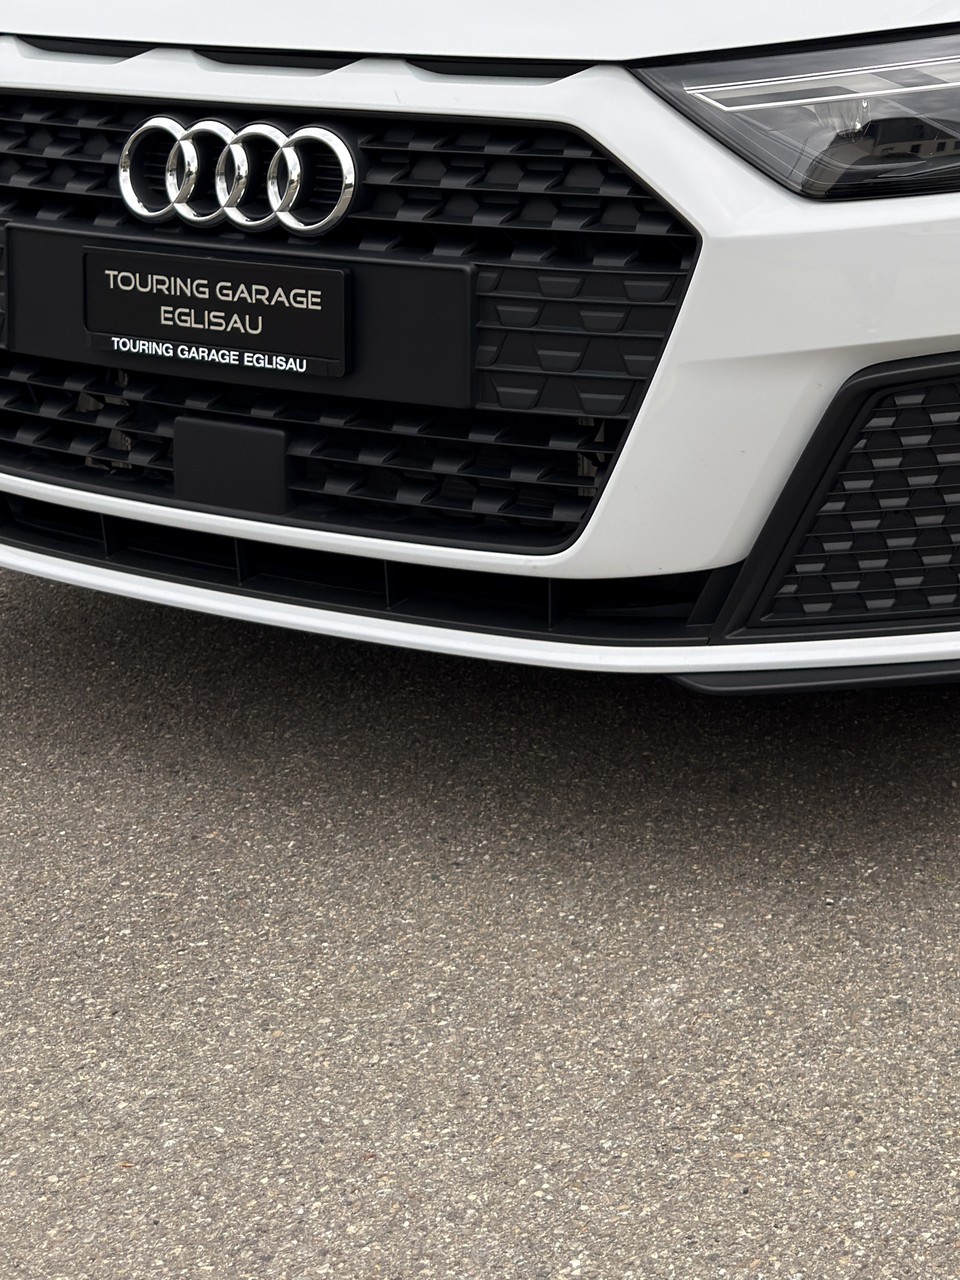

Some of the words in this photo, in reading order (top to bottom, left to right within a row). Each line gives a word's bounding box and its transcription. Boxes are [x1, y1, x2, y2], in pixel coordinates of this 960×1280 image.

[104, 269, 210, 299] TOURING
[215, 281, 322, 311] GARAGE
[160, 305, 263, 335] EGLISAU
[111, 336, 174, 357] TOURING
[177, 344, 240, 365] GARAGE
[243, 352, 307, 373] EGLISAU
